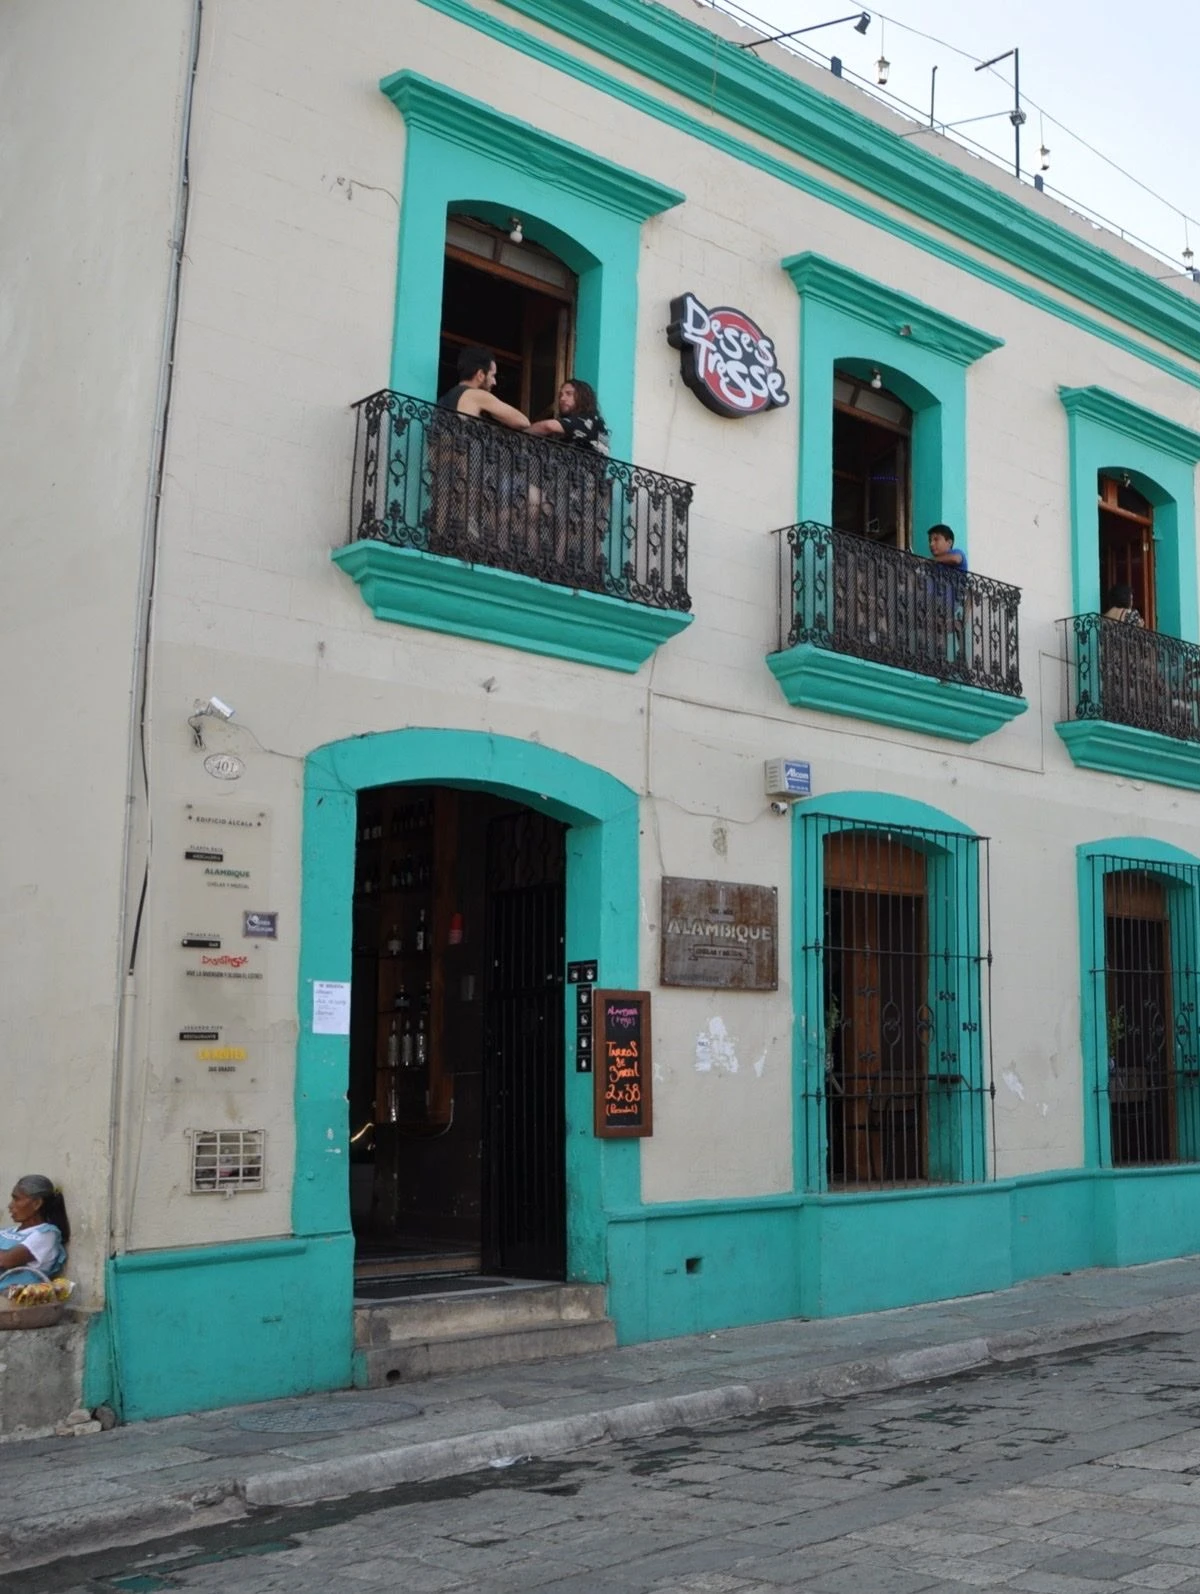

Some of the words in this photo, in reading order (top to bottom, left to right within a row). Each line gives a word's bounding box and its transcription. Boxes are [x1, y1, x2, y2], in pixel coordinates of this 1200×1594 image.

[214, 761, 235, 773] 401
[196, 816, 226, 825] EDIFICIO
[204, 867, 251, 879] ALAMBIQUE
[667, 918, 773, 944] ALAMBIQUE
